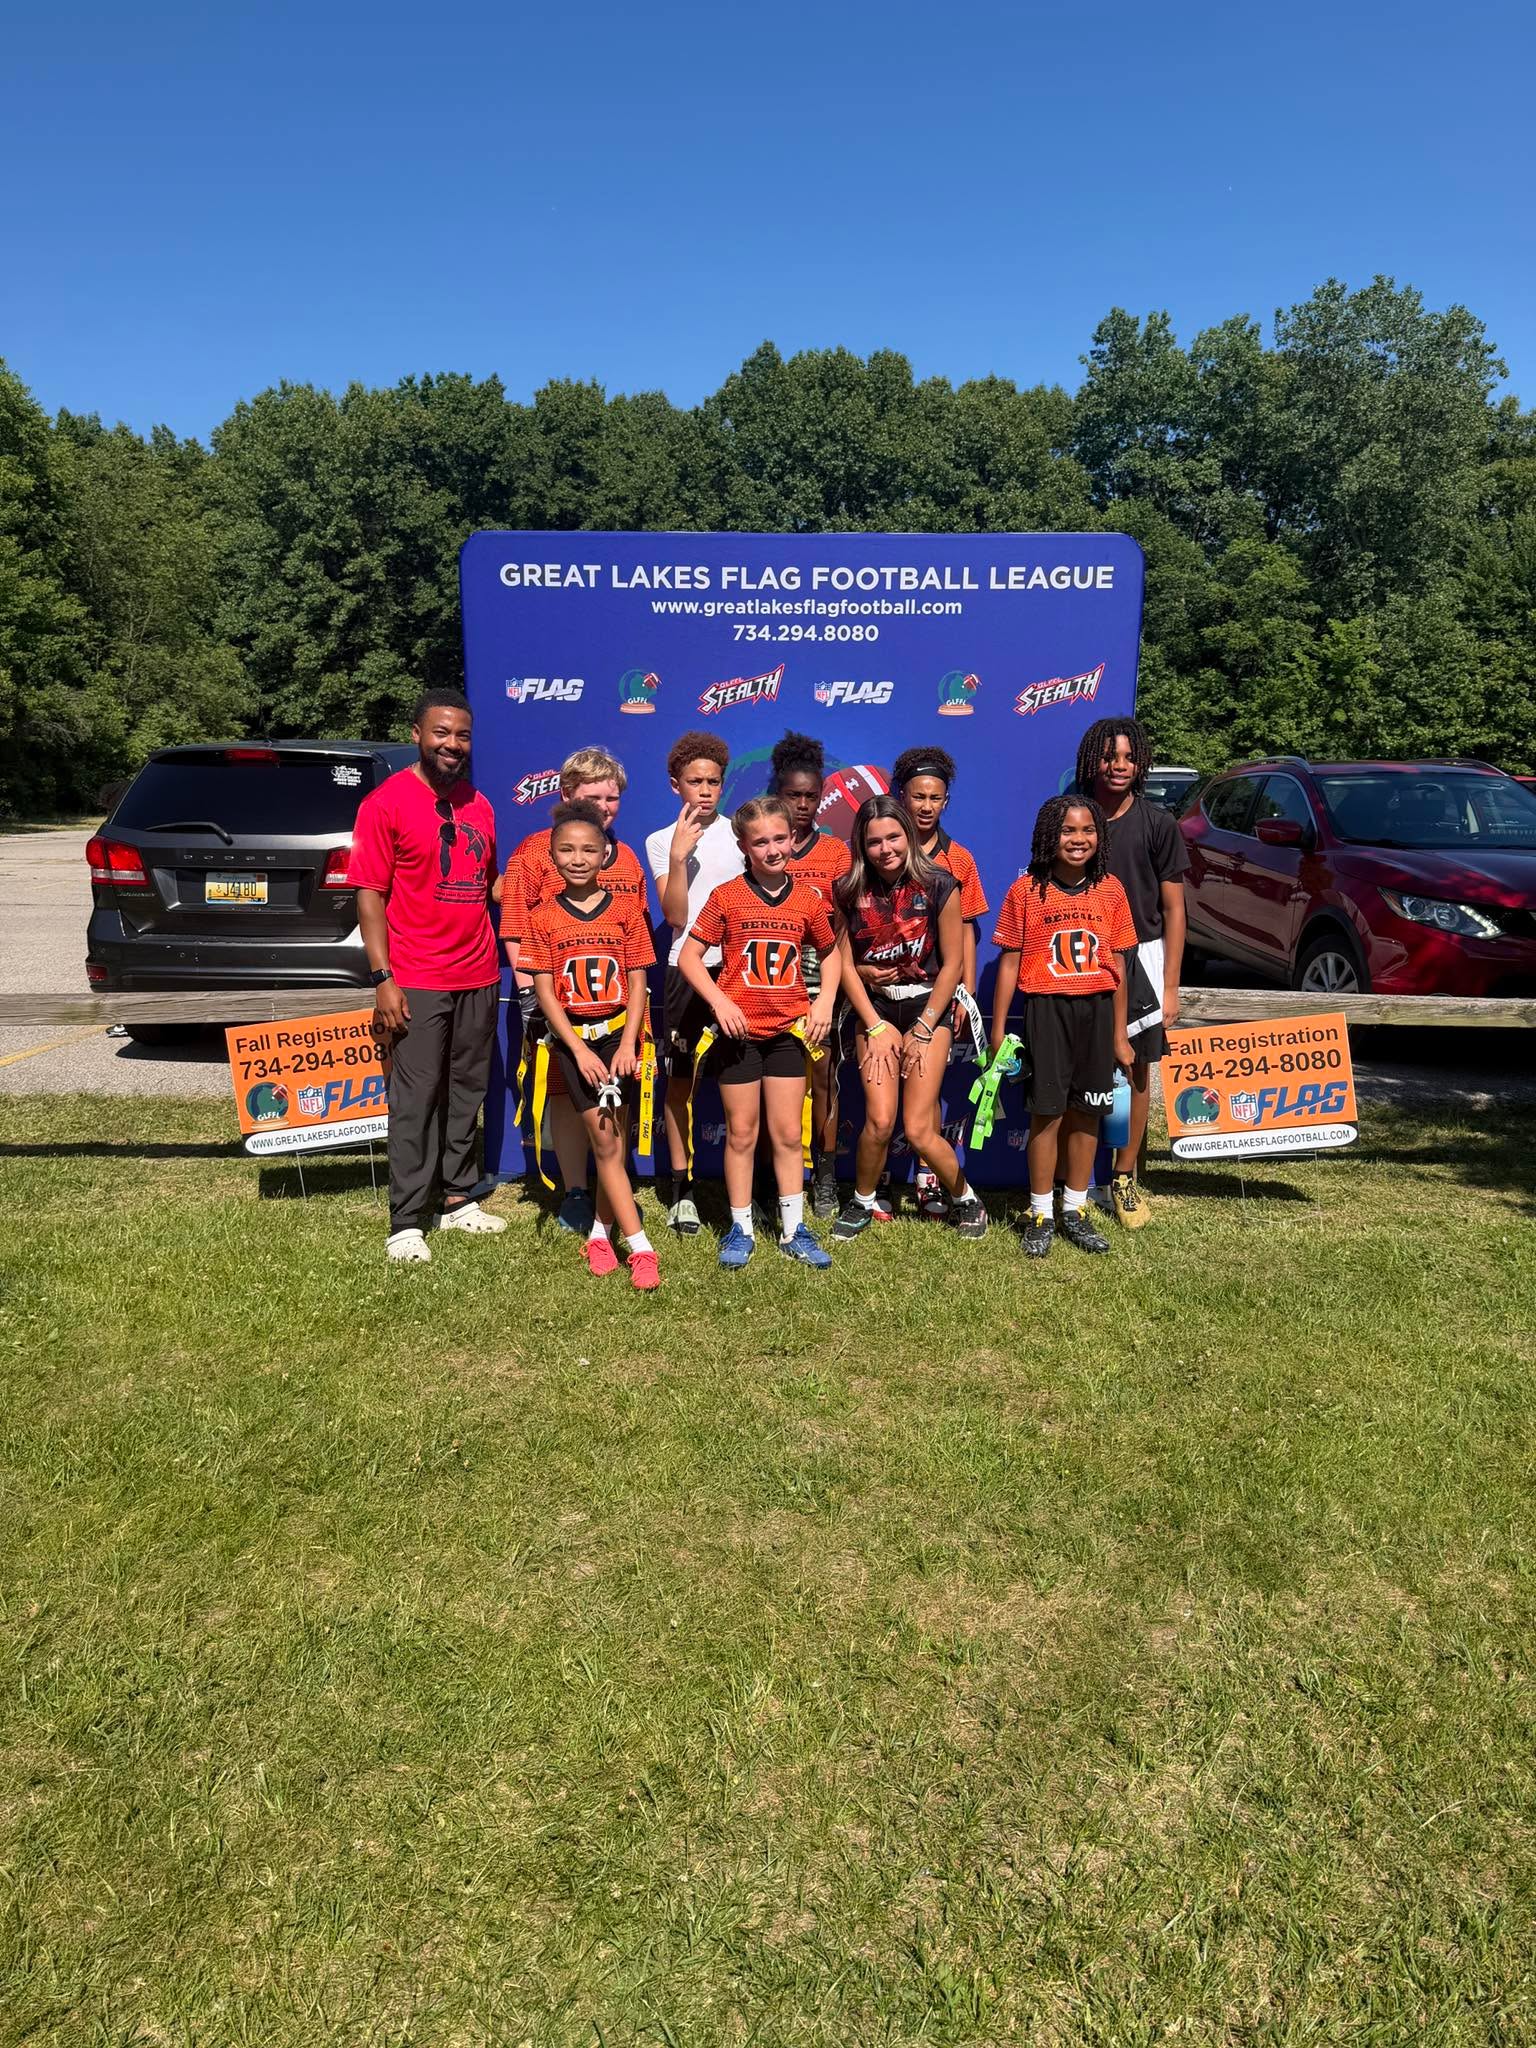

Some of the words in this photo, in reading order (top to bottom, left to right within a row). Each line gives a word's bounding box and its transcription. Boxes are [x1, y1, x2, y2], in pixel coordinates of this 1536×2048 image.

[499, 563, 601, 588] GREAT
[611, 565, 711, 590] LAKES
[721, 566, 801, 591] FLAG
[811, 566, 979, 591] FOOTBALL
[989, 565, 1115, 590] LEAGUE
[651, 599, 963, 617] www.greatlakesflagfootball.com
[733, 624, 879, 642] 734.294.8080
[518, 678, 585, 704] FLAG
[700, 666, 783, 713] STEALTH
[826, 681, 894, 707] FLAG
[1015, 666, 1102, 714] STEALTH
[516, 774, 561, 803] STEA
[741, 921, 805, 932] BENGALS
[1043, 912, 1103, 924] BENGALS
[557, 937, 622, 950] BENGALS
[236, 1034, 271, 1054] Fall
[277, 1021, 386, 1048] Registratio
[1167, 1038, 1203, 1057] Fall
[1210, 1027, 1339, 1054] Registration
[1169, 1049, 1341, 1083] 734-294-8080
[301, 1096, 323, 1111] NFL
[320, 1075, 390, 1120] FLA
[1233, 1104, 1256, 1119] NFL
[1252, 1081, 1348, 1126] FLAG
[257, 1111, 281, 1121] GLFFL
[1178, 1129, 1351, 1153] WWW.GREATLAKESFLAGFOOTBALL.COM
